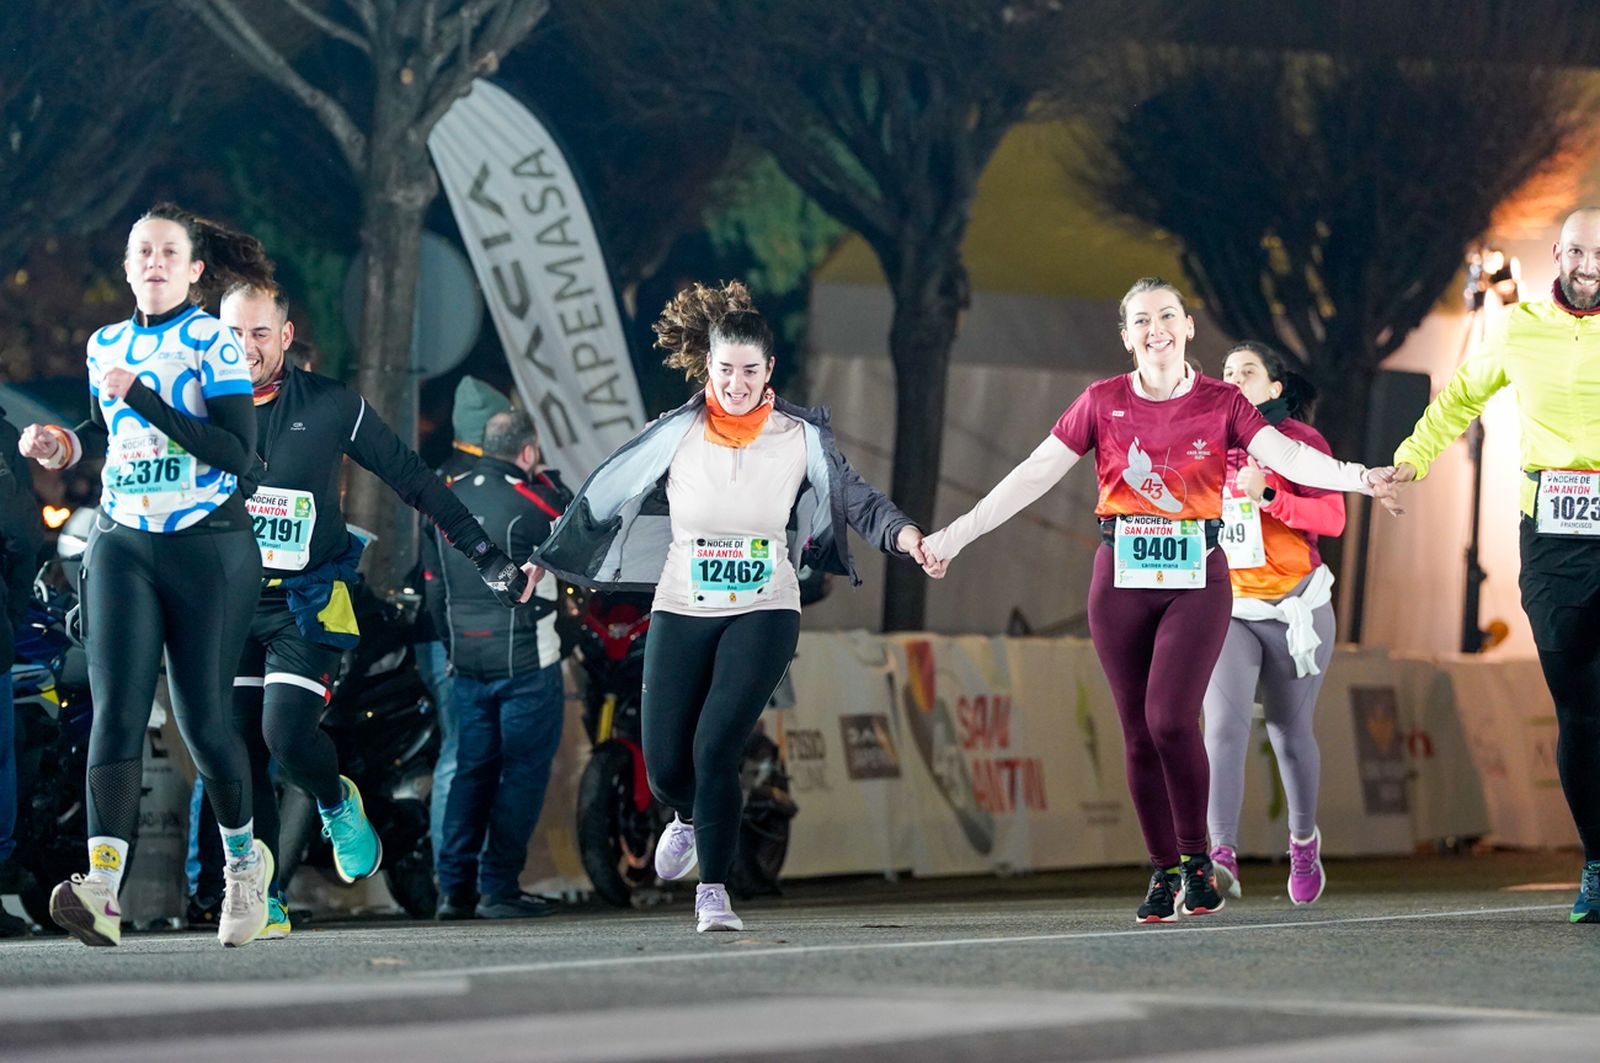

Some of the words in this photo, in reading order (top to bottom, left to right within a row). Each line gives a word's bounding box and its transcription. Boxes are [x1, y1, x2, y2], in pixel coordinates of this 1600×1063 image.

[511, 147, 636, 432] JAPEMASA
[1552, 475, 1579, 484] NOCHE
[1580, 476, 1591, 484] DE
[1140, 478, 1163, 500] 43
[245, 504, 257, 513] AN
[250, 495, 277, 506] NOCHE
[277, 498, 289, 507] DE
[251, 515, 302, 543] 2191
[1134, 516, 1162, 525] NOCHE
[1124, 526, 1142, 535] SAN
[707, 539, 733, 548] NOCHE
[1133, 536, 1188, 561] 9401
[697, 548, 714, 558] SAN
[715, 548, 744, 559] ANTÓN
[698, 559, 765, 584] 12462
[957, 693, 1012, 751] SAN
[971, 757, 1048, 813] ANTN
